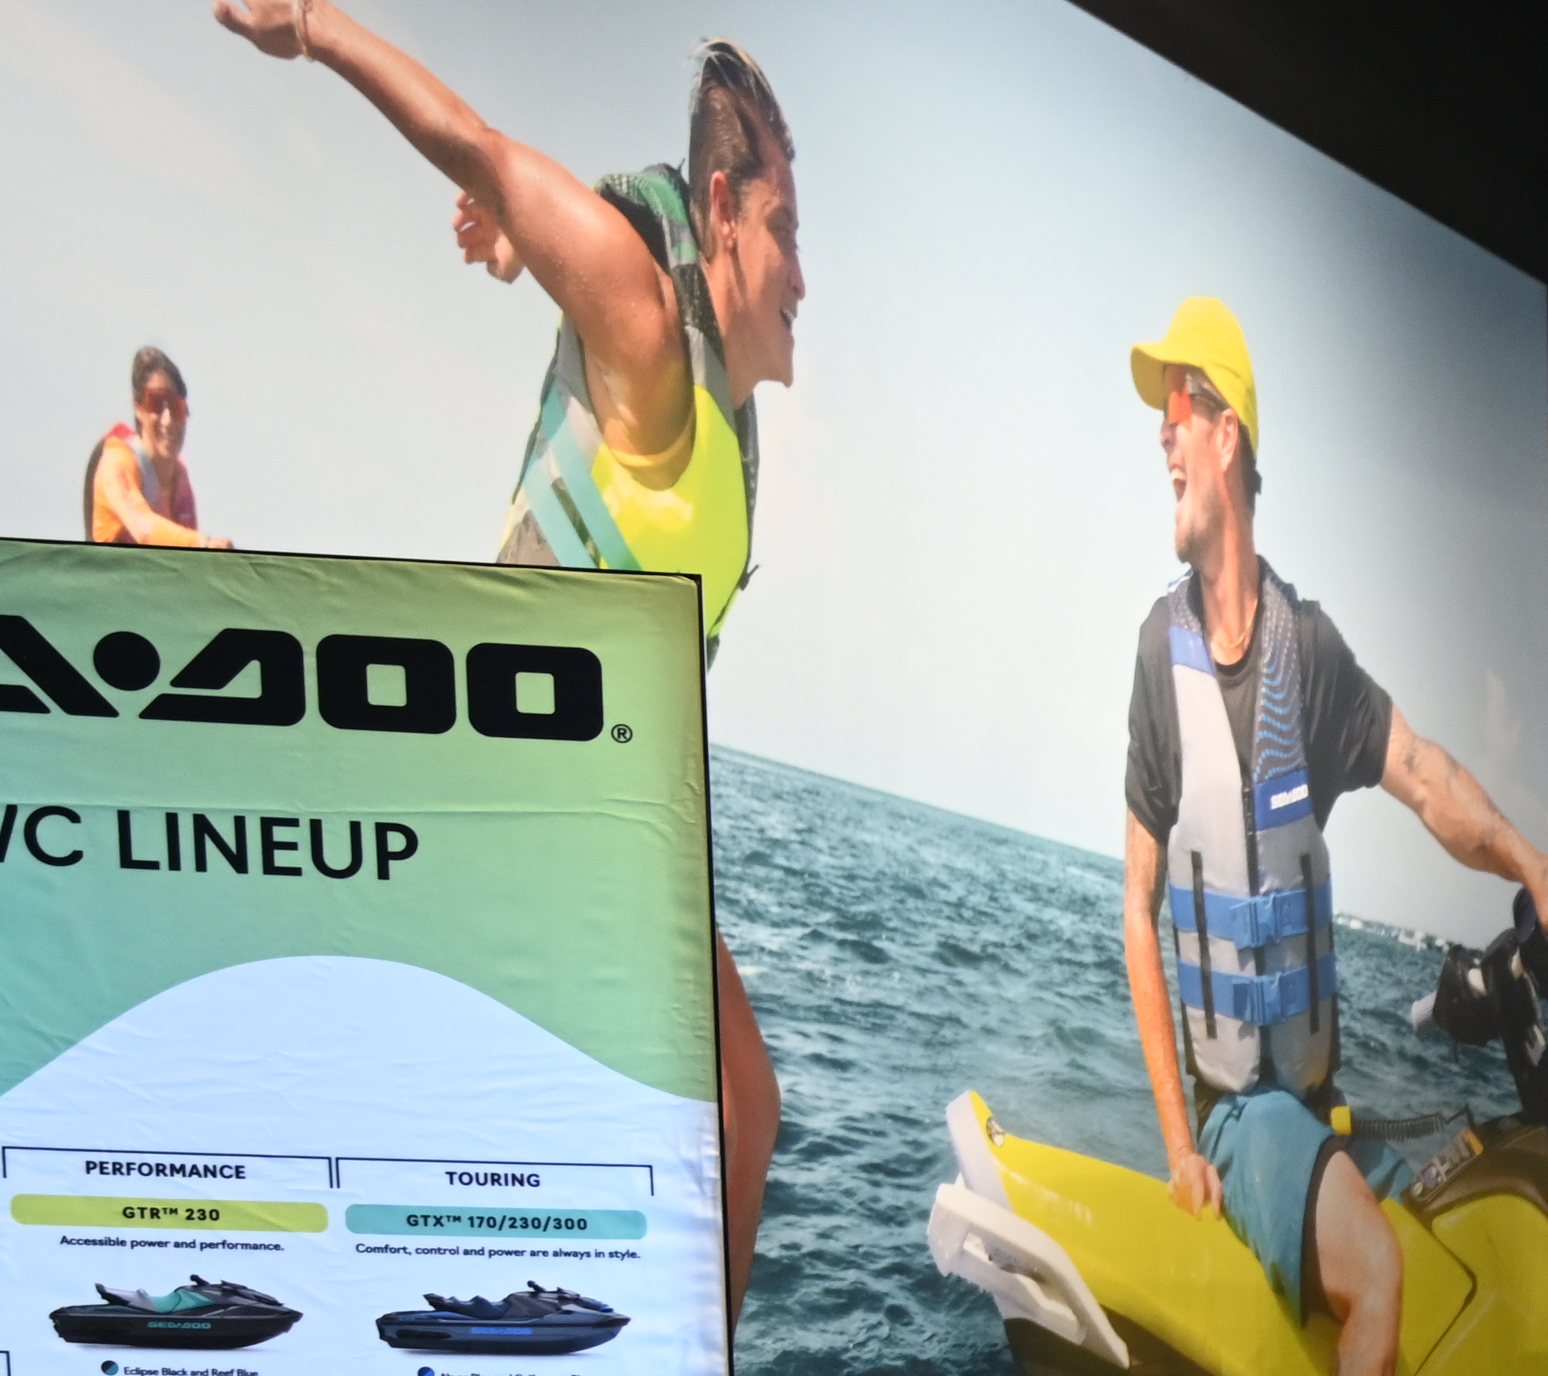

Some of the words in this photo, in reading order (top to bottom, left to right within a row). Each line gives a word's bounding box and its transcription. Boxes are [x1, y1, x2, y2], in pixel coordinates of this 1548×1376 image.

[117, 809, 419, 881] LINEUP
[85, 1160, 246, 1179] PERFORMANCE
[444, 1171, 540, 1187] TOURING
[184, 1208, 219, 1221] 230
[467, 1215, 587, 1231] 170/230/300
[59, 1235, 127, 1246] Accessible
[129, 1239, 170, 1249] power
[172, 1238, 196, 1248] and
[199, 1239, 284, 1251] performance.
[354, 1243, 412, 1255] Comfort,
[414, 1246, 459, 1255] control
[462, 1246, 485, 1256] and
[487, 1248, 527, 1258] power
[528, 1249, 549, 1257] are
[551, 1248, 591, 1260] always
[594, 1248, 605, 1258] in
[607, 1249, 640, 1261] style.
[123, 1366, 159, 1376] Eclipse
[161, 1367, 188, 1376] Black
[189, 1368, 209, 1376] and
[210, 1368, 234, 1376] Reef
[236, 1368, 258, 1376] Blue
